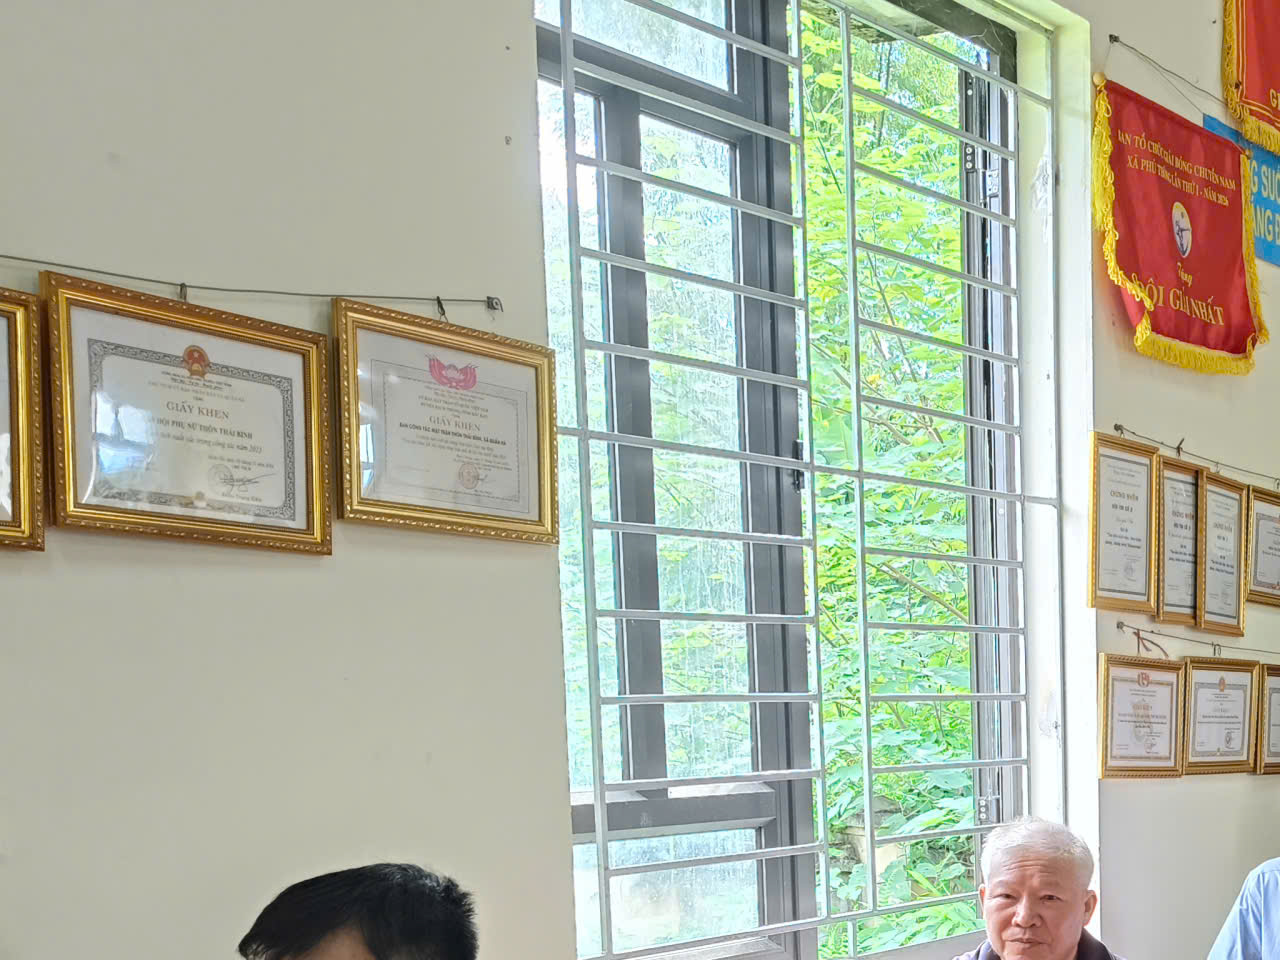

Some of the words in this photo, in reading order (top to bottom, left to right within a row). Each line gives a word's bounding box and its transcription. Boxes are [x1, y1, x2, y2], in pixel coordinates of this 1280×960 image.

[1175, 155, 1193, 175] BÓNG
[1219, 175, 1236, 192] NAM
[1190, 295, 1225, 326] NHẤT
[167, 399, 195, 416] GIẤY
[198, 406, 230, 420] KHEN
[171, 418, 186, 431] PHỤ
[199, 423, 219, 434] THÔN
[454, 420, 481, 432] KHEN
